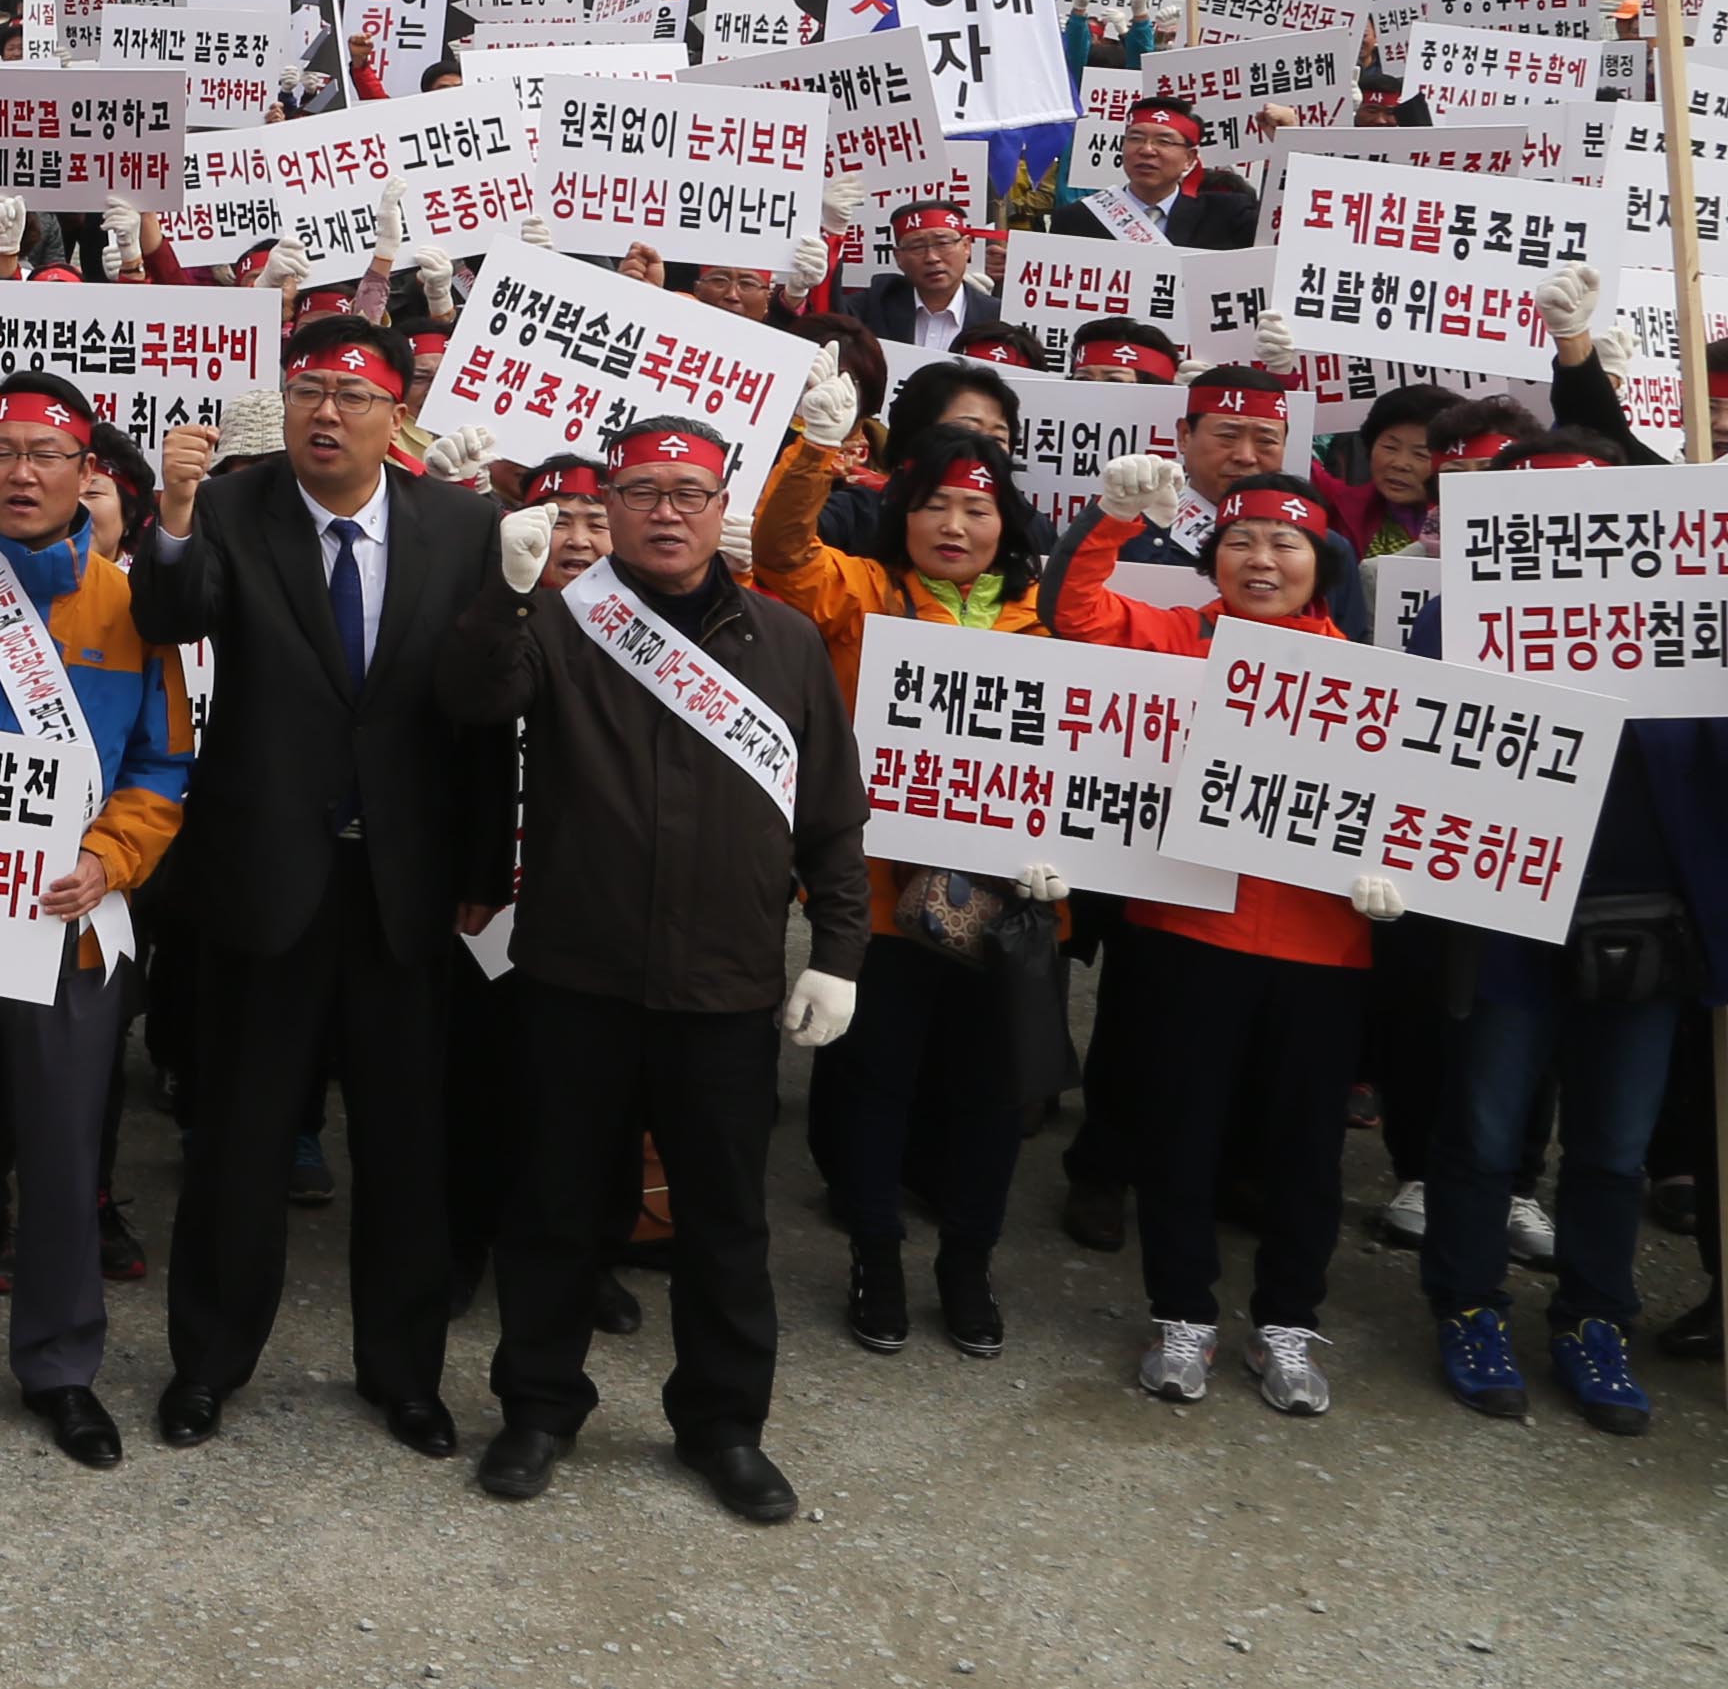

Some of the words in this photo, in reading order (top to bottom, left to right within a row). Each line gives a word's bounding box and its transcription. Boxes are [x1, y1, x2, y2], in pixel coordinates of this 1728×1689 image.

[112, 30, 186, 62] 지자체간
[195, 31, 269, 67] 갈등조장
[1504, 51, 1587, 89] 무능함에
[1248, 51, 1336, 97] 힘을합해
[70, 94, 172, 134] 인정하고
[559, 98, 678, 159] 원칙없이
[687, 113, 810, 172] 눈치보면
[277, 133, 390, 195] 억지주장
[398, 116, 512, 170] 그만하고
[423, 172, 535, 236] 존중하라
[550, 170, 671, 230] 성난민심
[678, 180, 798, 240] 일어난다
[1017, 260, 1132, 315] 성난민심
[44, 403, 72, 427] 수
[450, 344, 602, 443] 분쟁조정
[657, 435, 691, 459] 수
[540, 472, 563, 493] 사
[1222, 493, 1244, 517] 사
[1280, 497, 1310, 522] 수
[888, 660, 1044, 746] 헌재판결
